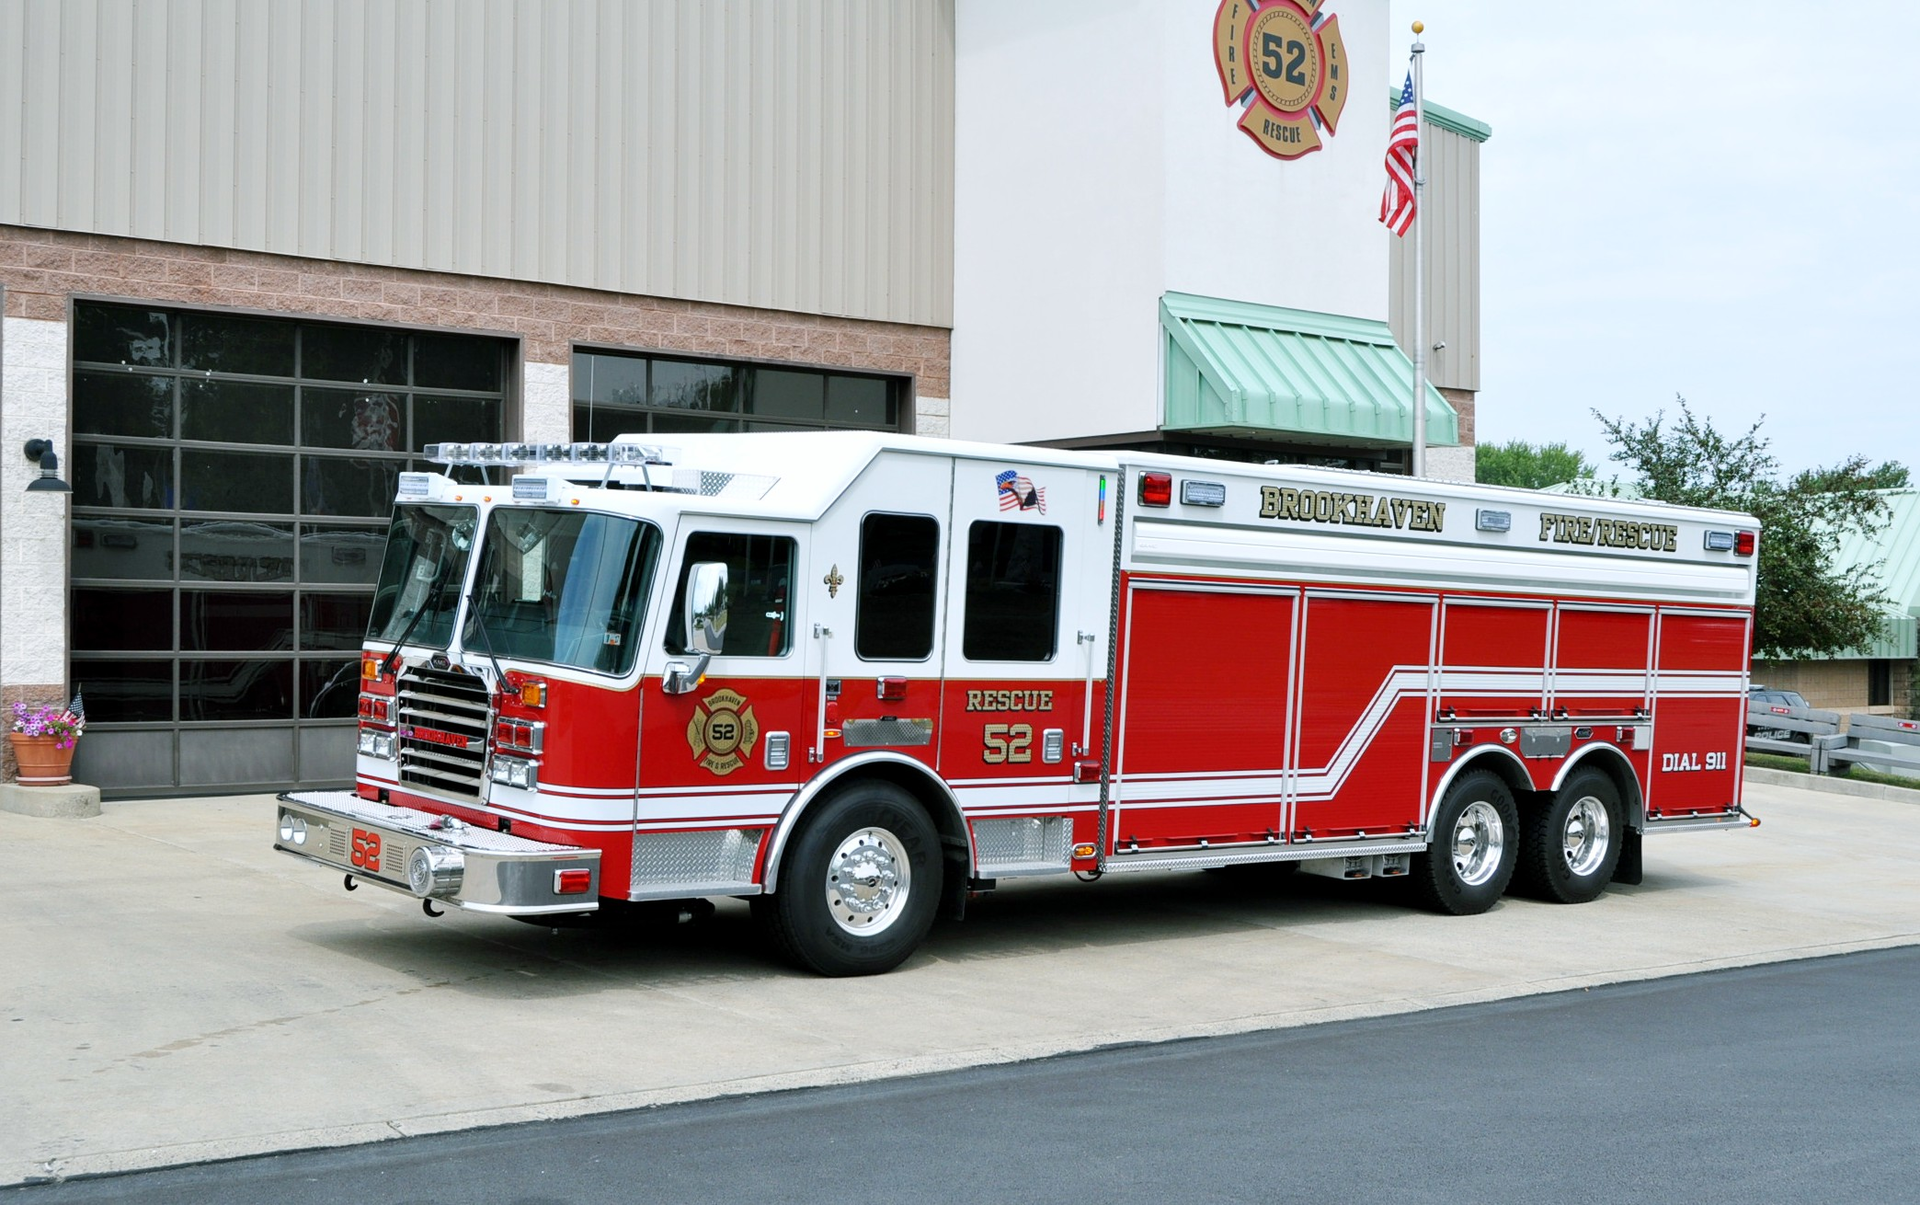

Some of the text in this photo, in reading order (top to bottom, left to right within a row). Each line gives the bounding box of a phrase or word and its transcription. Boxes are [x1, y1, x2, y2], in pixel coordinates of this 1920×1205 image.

[1229, 4, 1238, 85] FIRE
[1262, 32, 1306, 87] 52
[1329, 43, 1338, 101] EMS
[1263, 118, 1301, 143] RESCUE
[1259, 485, 1446, 533] BROOKHAVEN
[1539, 512, 1677, 552] FIRE/RESCUE
[707, 694, 741, 708] BROOKHAVEN
[965, 690, 1053, 712] RESCUE
[712, 723, 735, 740] 52
[983, 723, 1033, 764] 52
[1754, 730, 1791, 740] POLICE
[704, 757, 715, 769] FIRE
[720, 757, 740, 769] RESCUE
[1662, 752, 1727, 772] DIAL 911
[350, 827, 382, 873] 52
